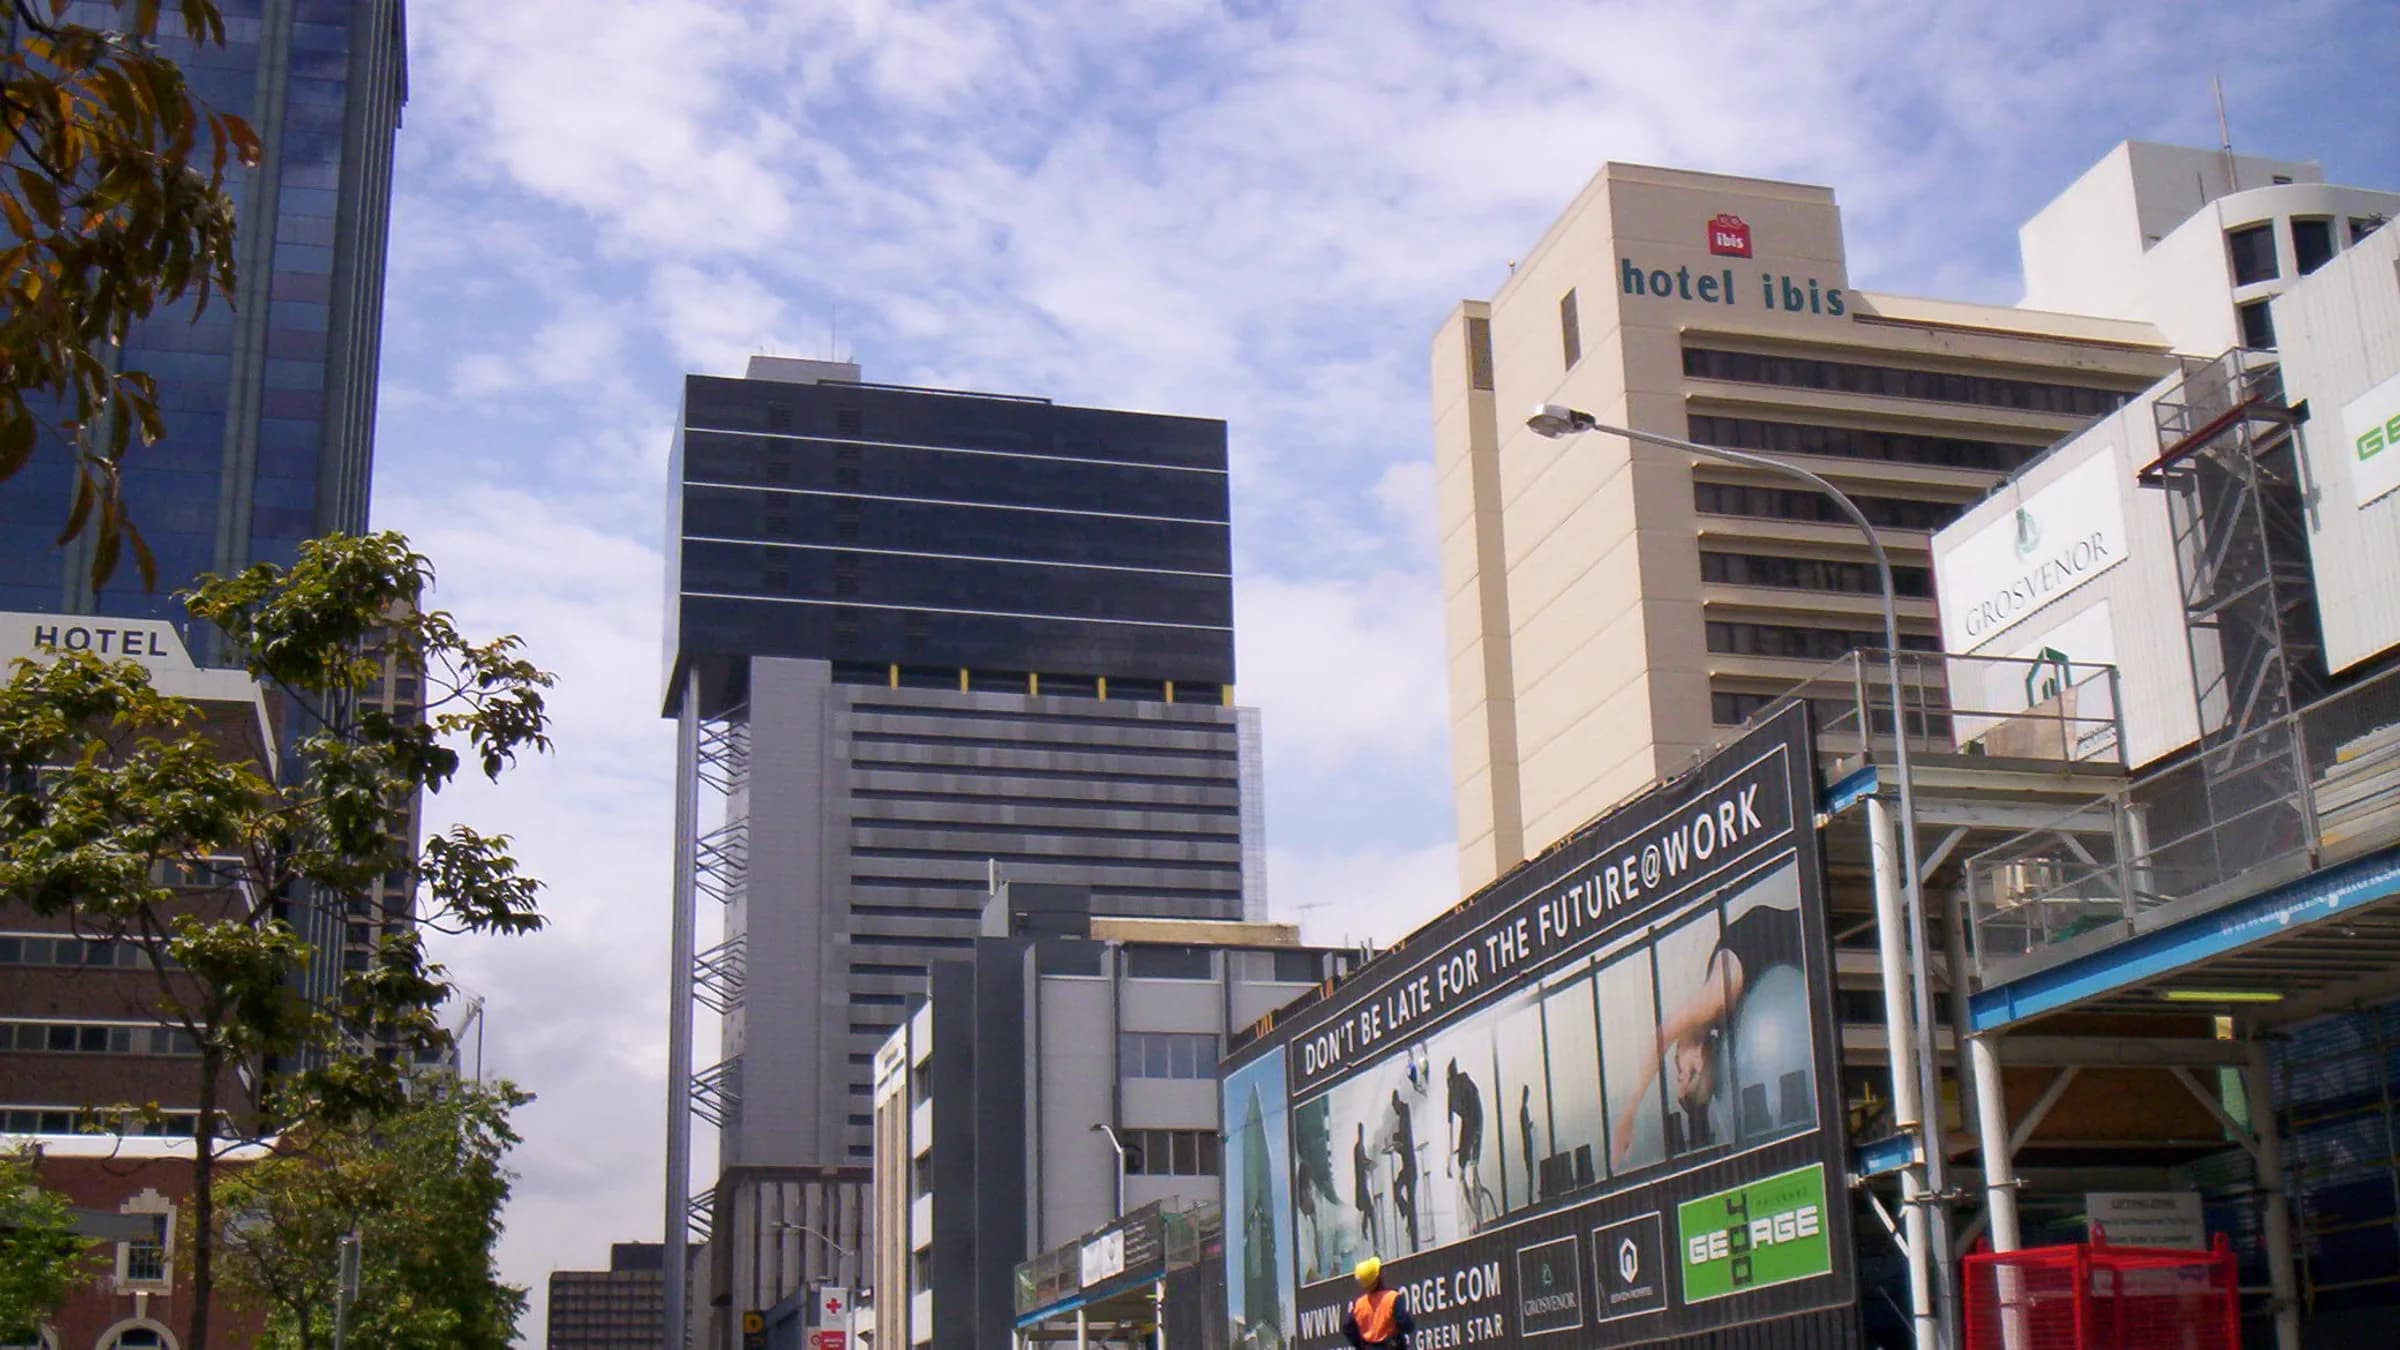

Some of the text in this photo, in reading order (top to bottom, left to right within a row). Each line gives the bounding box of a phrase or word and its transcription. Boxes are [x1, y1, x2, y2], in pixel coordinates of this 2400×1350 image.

[1716, 231, 1744, 249] ibis
[1621, 258, 1844, 316] hotel ibis
[1965, 532, 2109, 637] GROSVENOR
[34, 625, 167, 656] HOTEL
[1305, 783, 1762, 1075] DON'T BE LATE FOR THE FUTURE@WORK
[1415, 1323, 1461, 1350] GREEN
[1467, 1313, 1503, 1343] STAR
